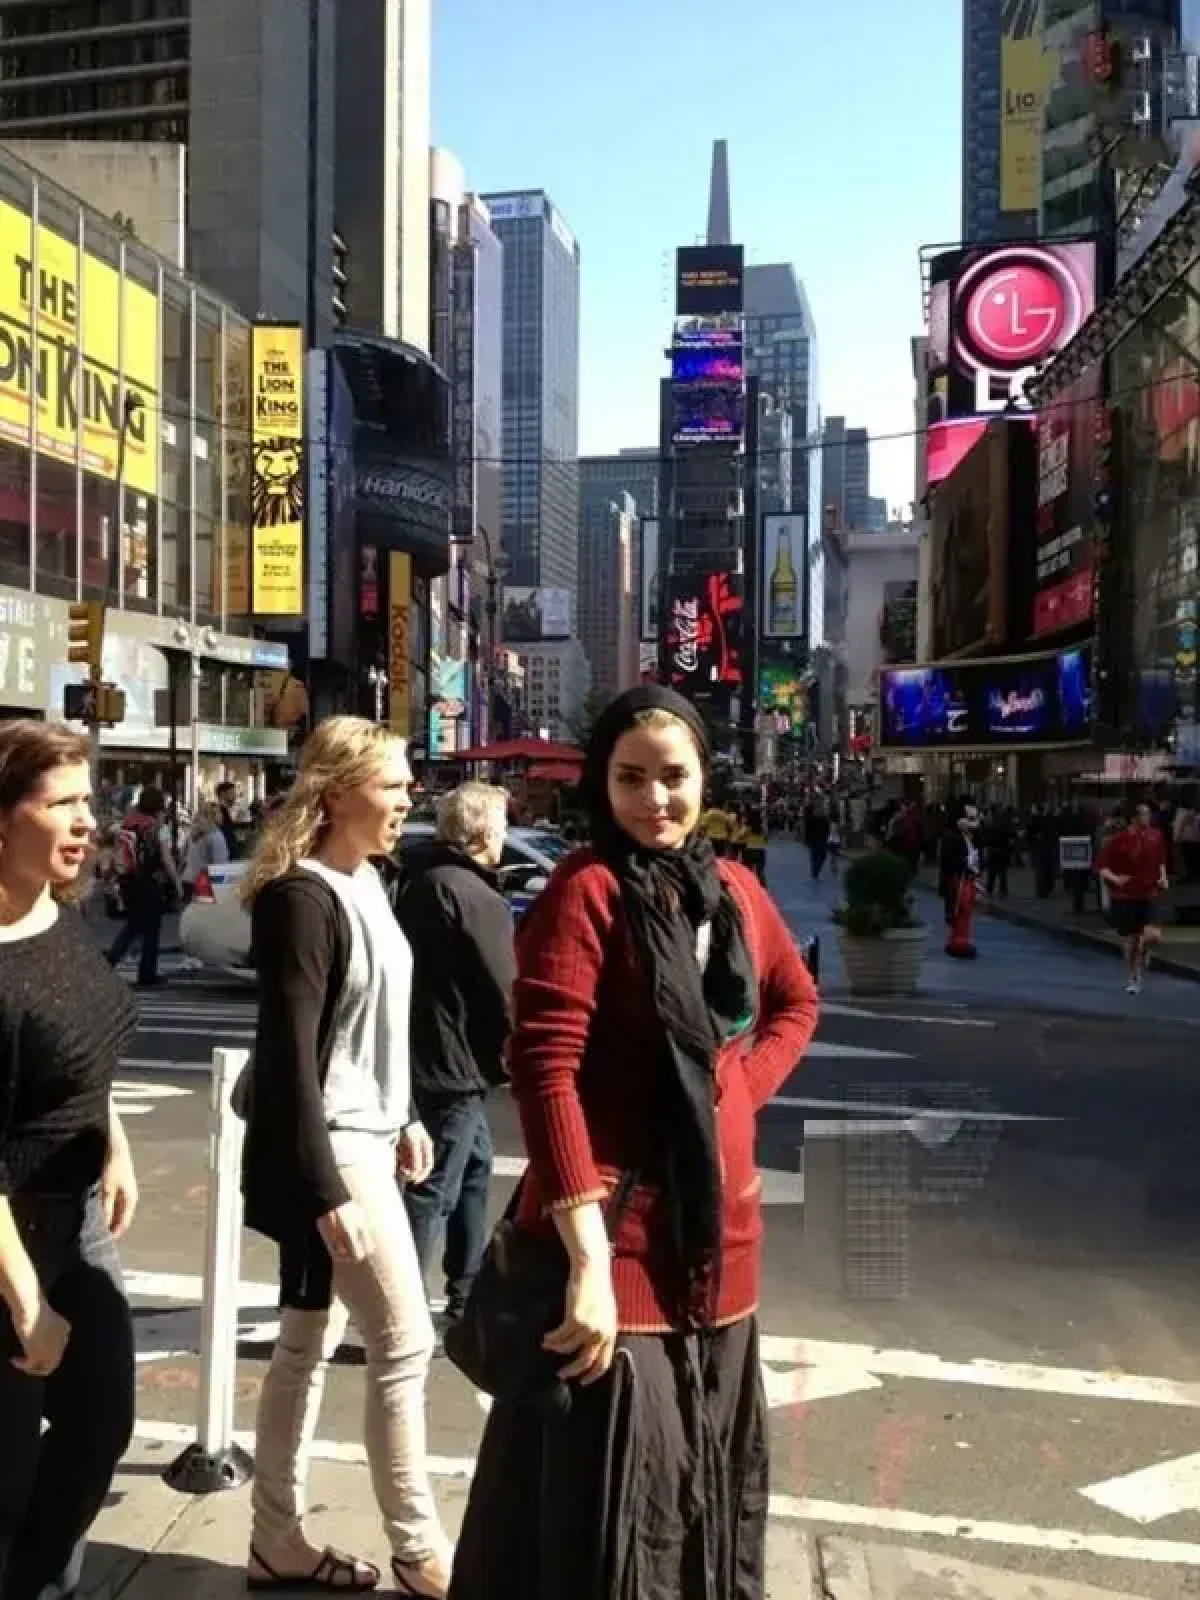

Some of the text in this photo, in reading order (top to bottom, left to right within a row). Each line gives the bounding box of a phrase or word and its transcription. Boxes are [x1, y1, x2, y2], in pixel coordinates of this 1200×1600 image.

[14, 253, 77, 324] THE
[973, 271, 1057, 354] LG
[56, 335, 146, 442] KING
[259, 375, 295, 393] LION
[262, 361, 289, 373] THE
[257, 395, 299, 416] KING
[391, 604, 408, 694] Kodak
